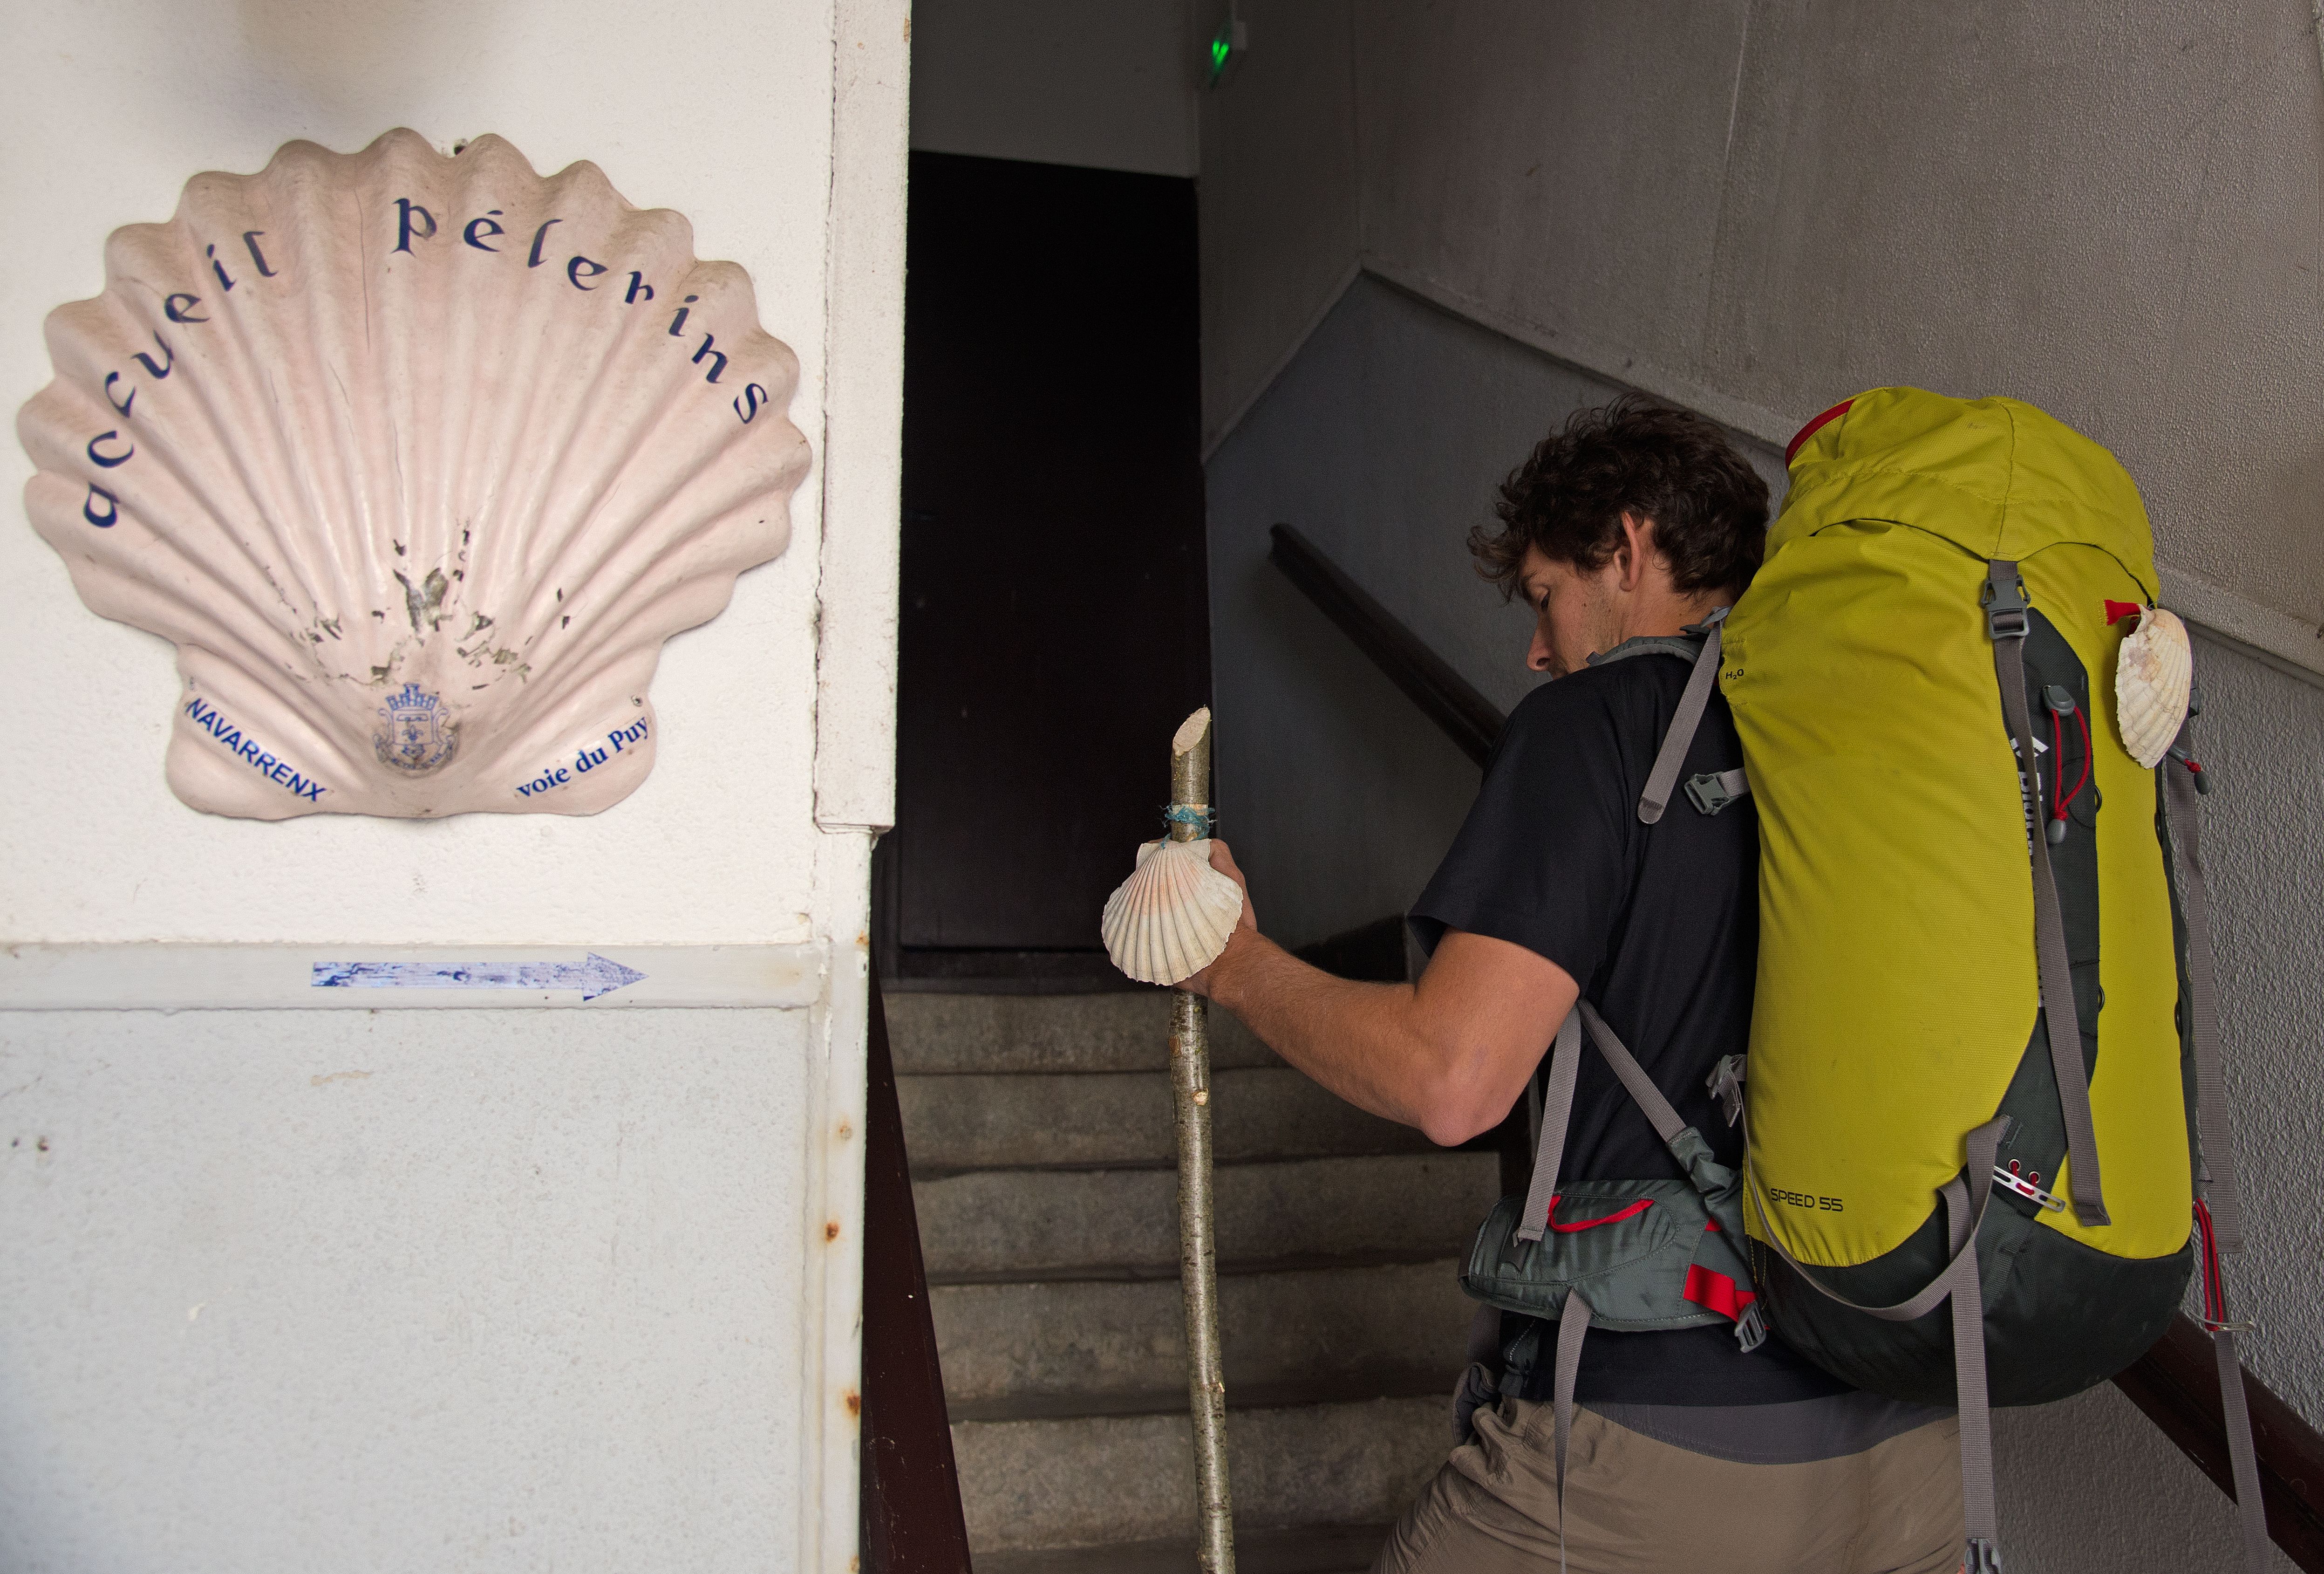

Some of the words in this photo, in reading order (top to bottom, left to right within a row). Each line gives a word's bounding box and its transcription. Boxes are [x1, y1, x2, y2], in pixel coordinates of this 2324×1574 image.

[83, 231, 278, 528] accueil
[392, 198, 768, 424] pélerins
[186, 698, 327, 802] NAVARRENX
[516, 768, 571, 797] voie
[575, 748, 608, 773] du
[607, 716, 648, 753] Puy
[1770, 1188, 1815, 1208] SPEED
[1819, 1196, 1843, 1212] 55
